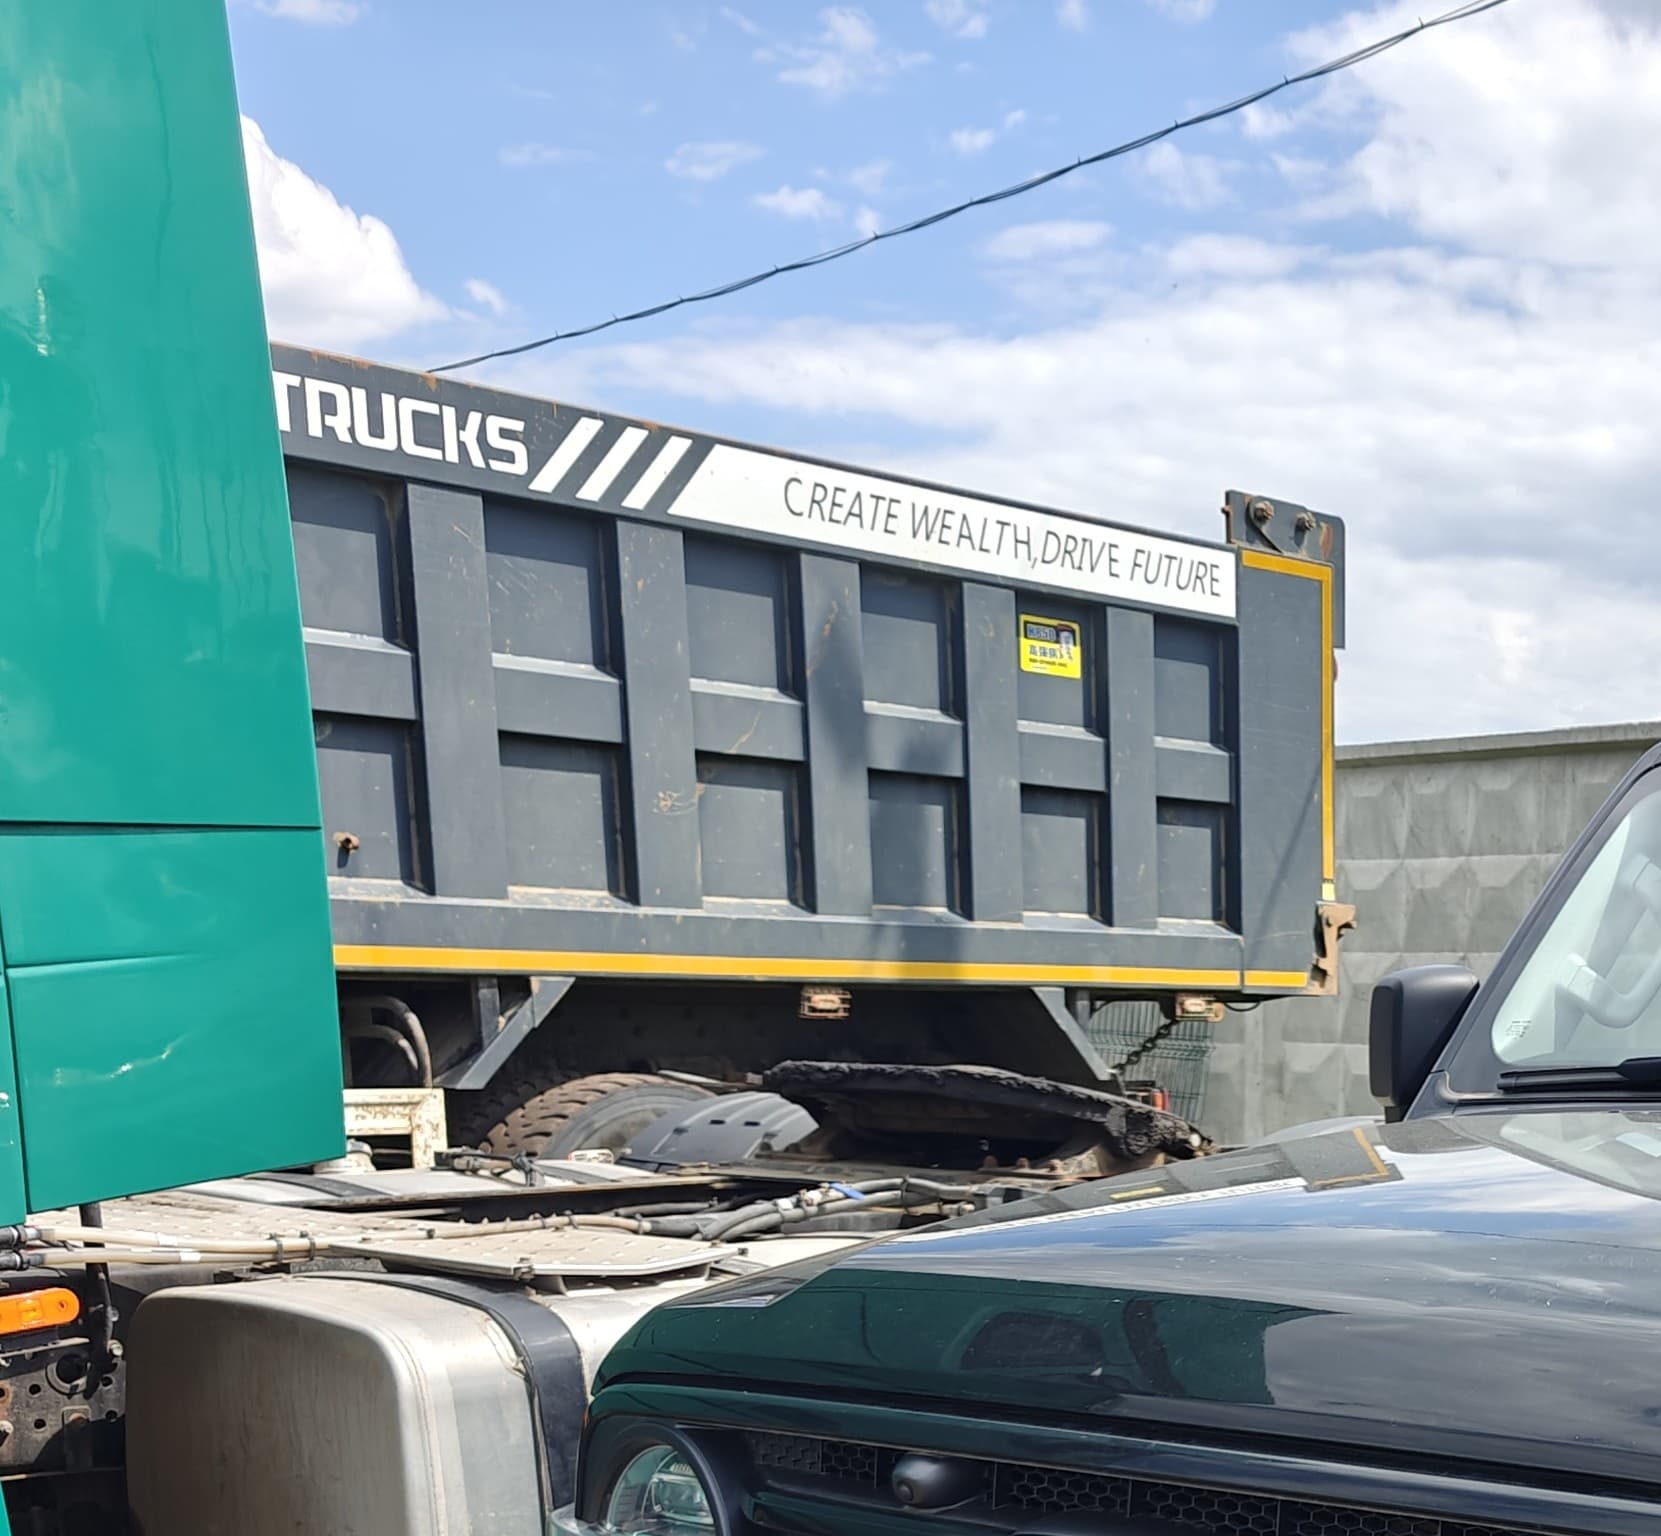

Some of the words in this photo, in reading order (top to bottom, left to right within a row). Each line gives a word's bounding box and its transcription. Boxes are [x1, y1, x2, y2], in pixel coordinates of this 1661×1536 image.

[272, 370, 529, 476] TRUCKS
[784, 477, 902, 536] CREATE
[1130, 548, 1222, 598] FUTURE
